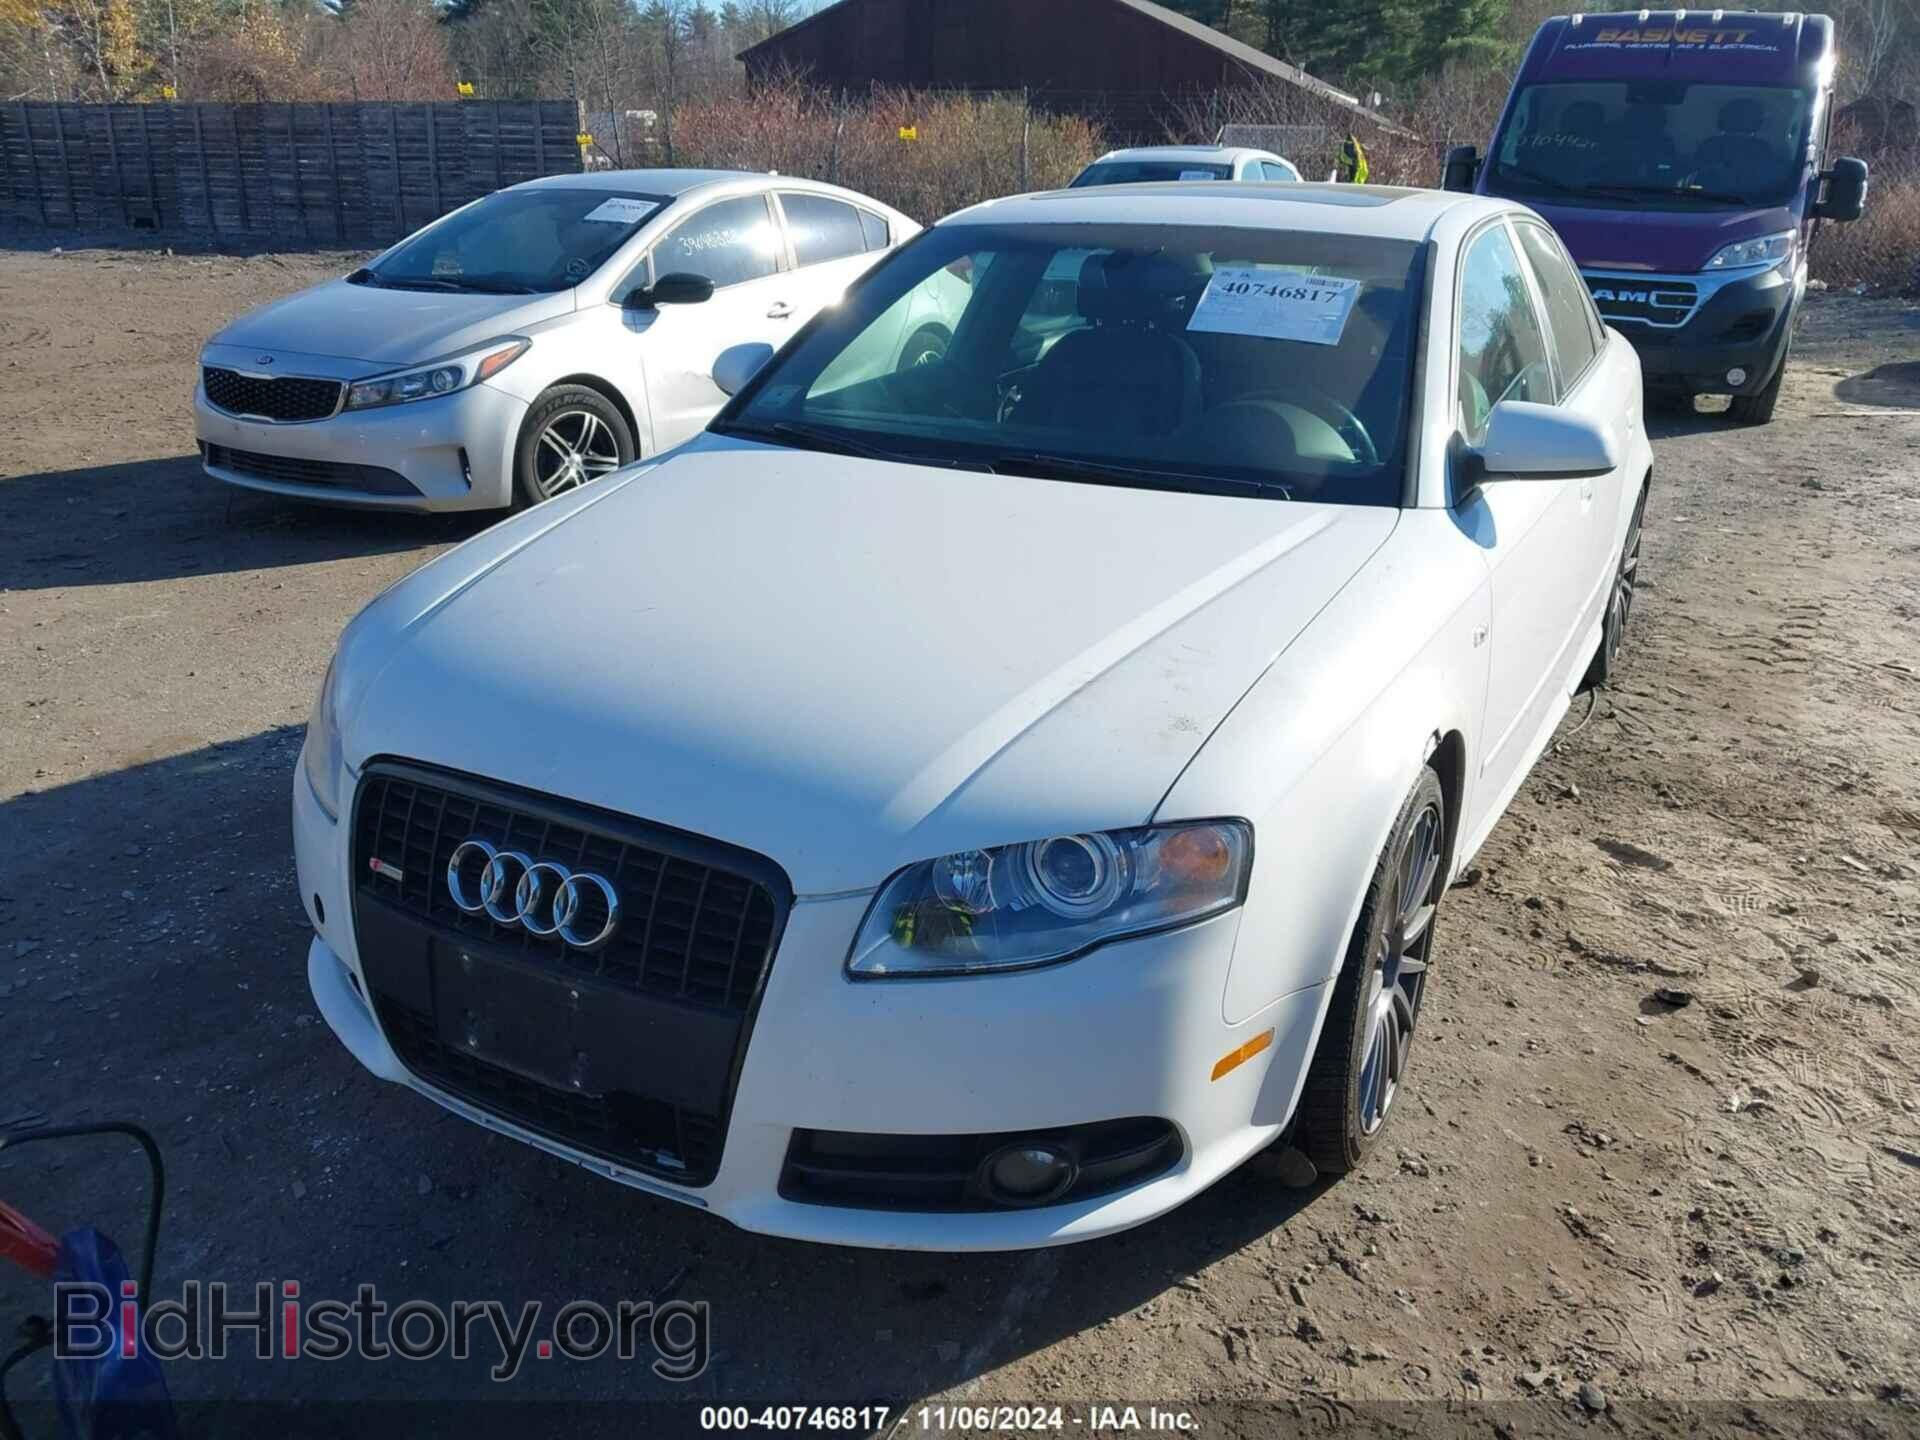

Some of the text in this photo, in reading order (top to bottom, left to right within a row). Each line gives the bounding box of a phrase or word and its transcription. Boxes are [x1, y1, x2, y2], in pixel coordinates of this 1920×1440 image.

[1595, 28, 1756, 42] BASNETT
[1222, 281, 1340, 303] 40746817
[1592, 288, 1649, 303] AM
